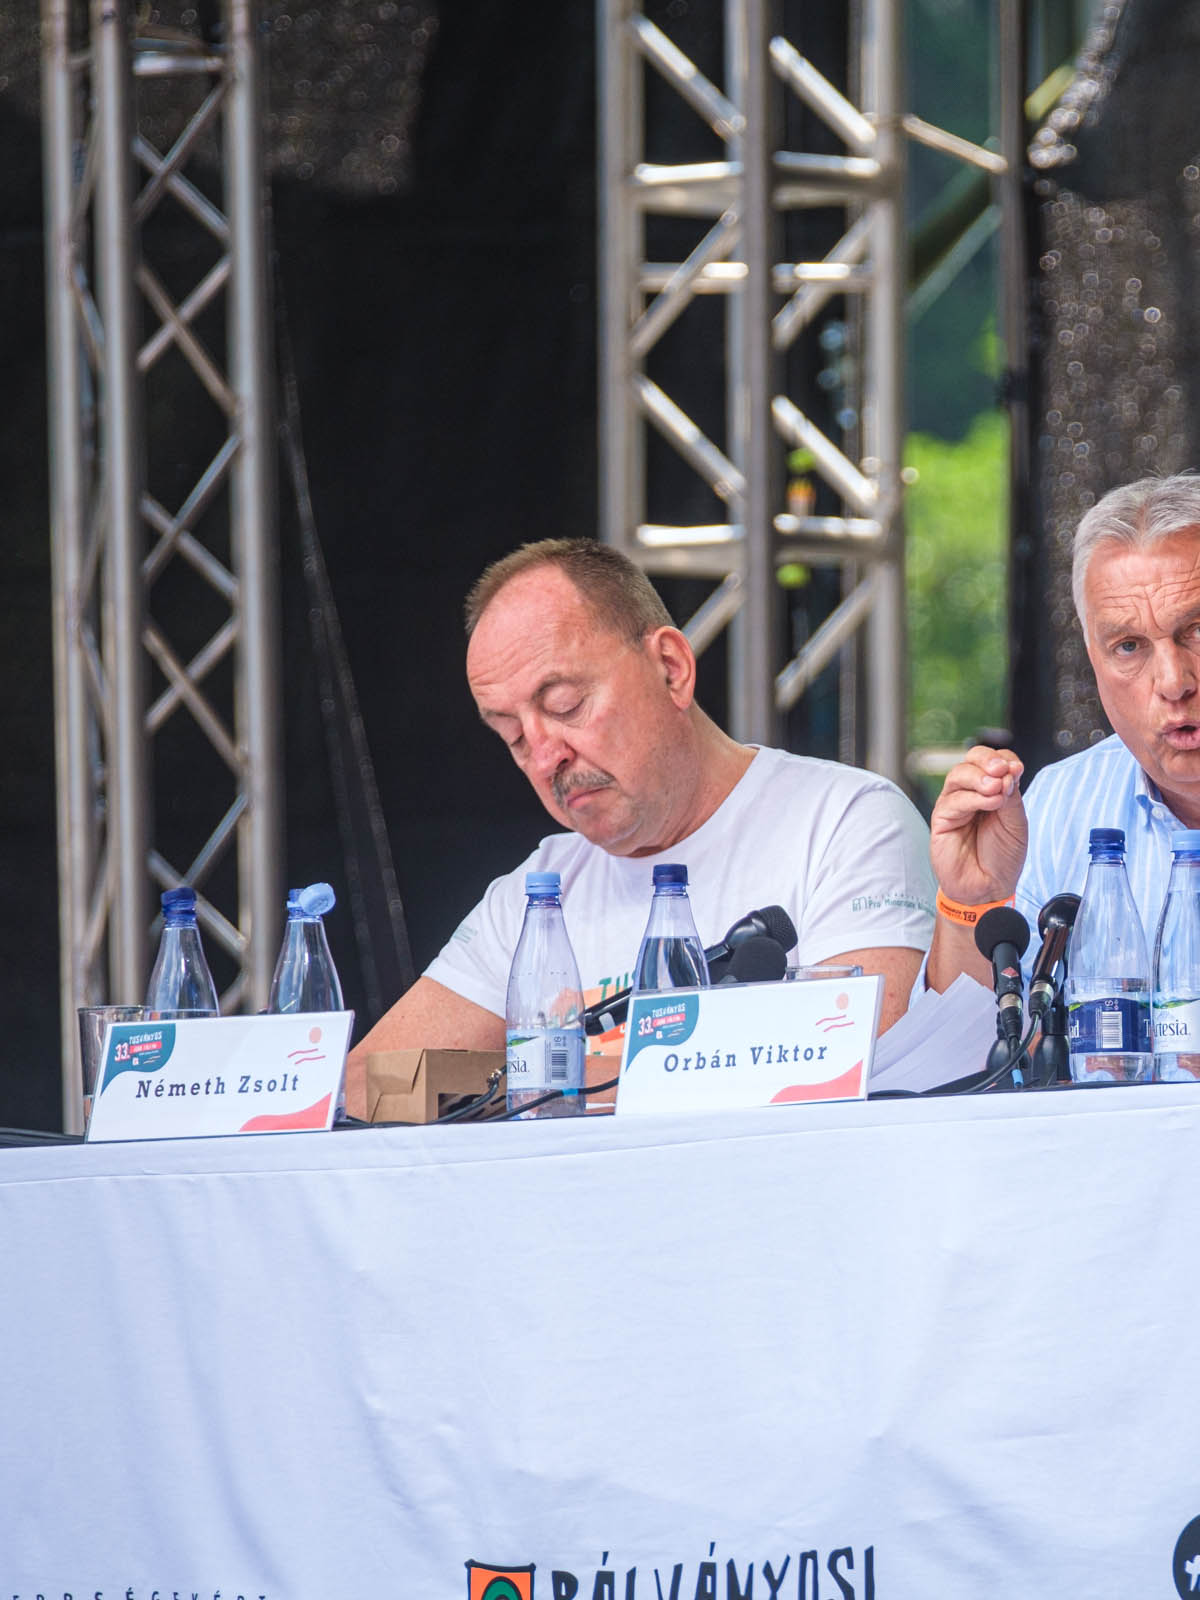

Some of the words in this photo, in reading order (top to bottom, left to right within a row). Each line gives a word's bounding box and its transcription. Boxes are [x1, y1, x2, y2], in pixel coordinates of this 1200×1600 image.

[638, 1015, 655, 1036] 33.
[114, 1042, 131, 1062] 33.
[663, 1049, 737, 1072] Orbán
[749, 1044, 828, 1065] Viktor
[135, 1077, 226, 1098] Németh
[238, 1073, 300, 1094] Zsolt
